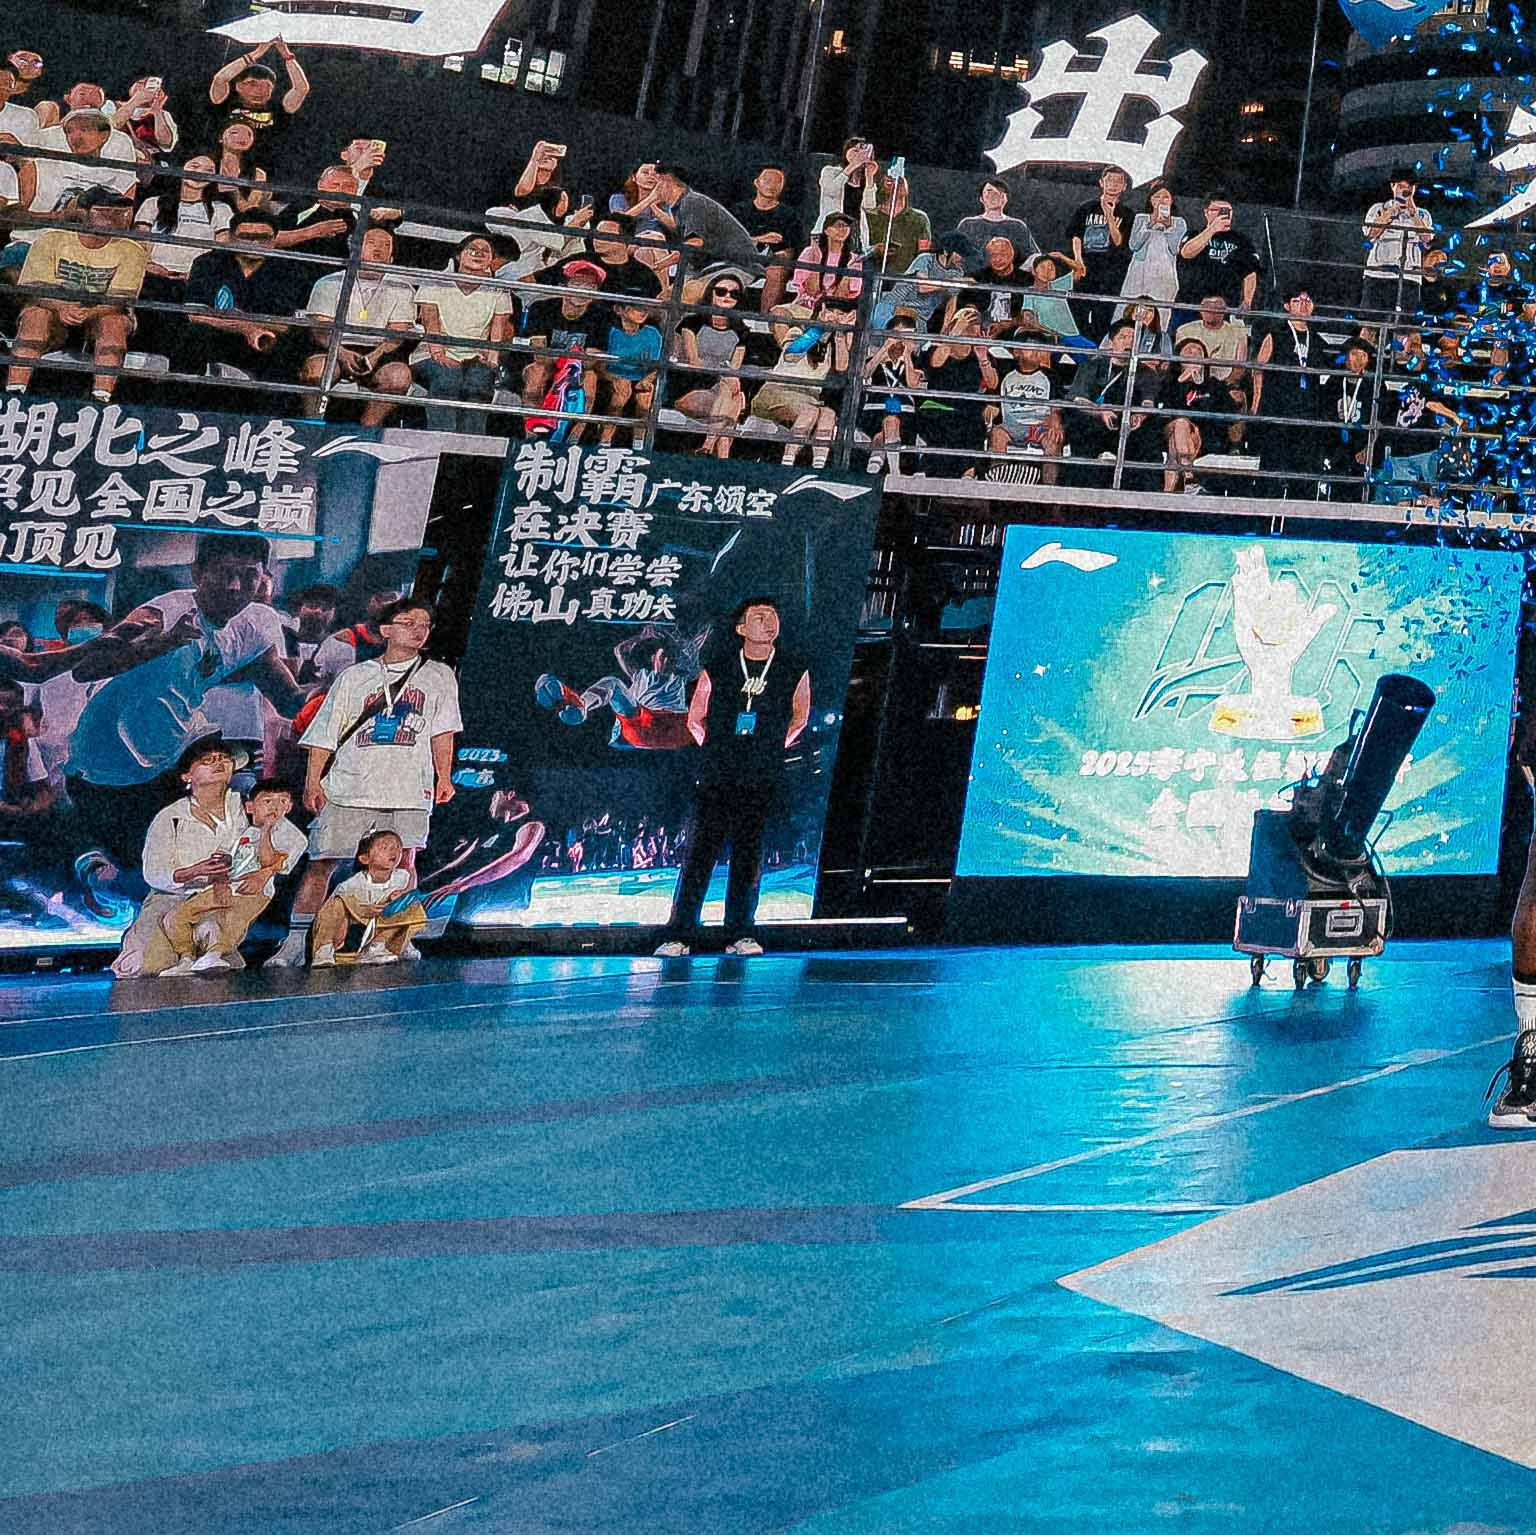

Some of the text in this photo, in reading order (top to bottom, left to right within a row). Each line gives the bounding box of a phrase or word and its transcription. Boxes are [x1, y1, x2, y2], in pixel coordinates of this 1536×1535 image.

[984, 13, 1208, 188] 出
[0, 520, 121, 568] 顶见
[503, 501, 653, 550] 在决赛
[499, 544, 682, 587] 让你们尝尝
[489, 582, 678, 625] 佛山真功夫
